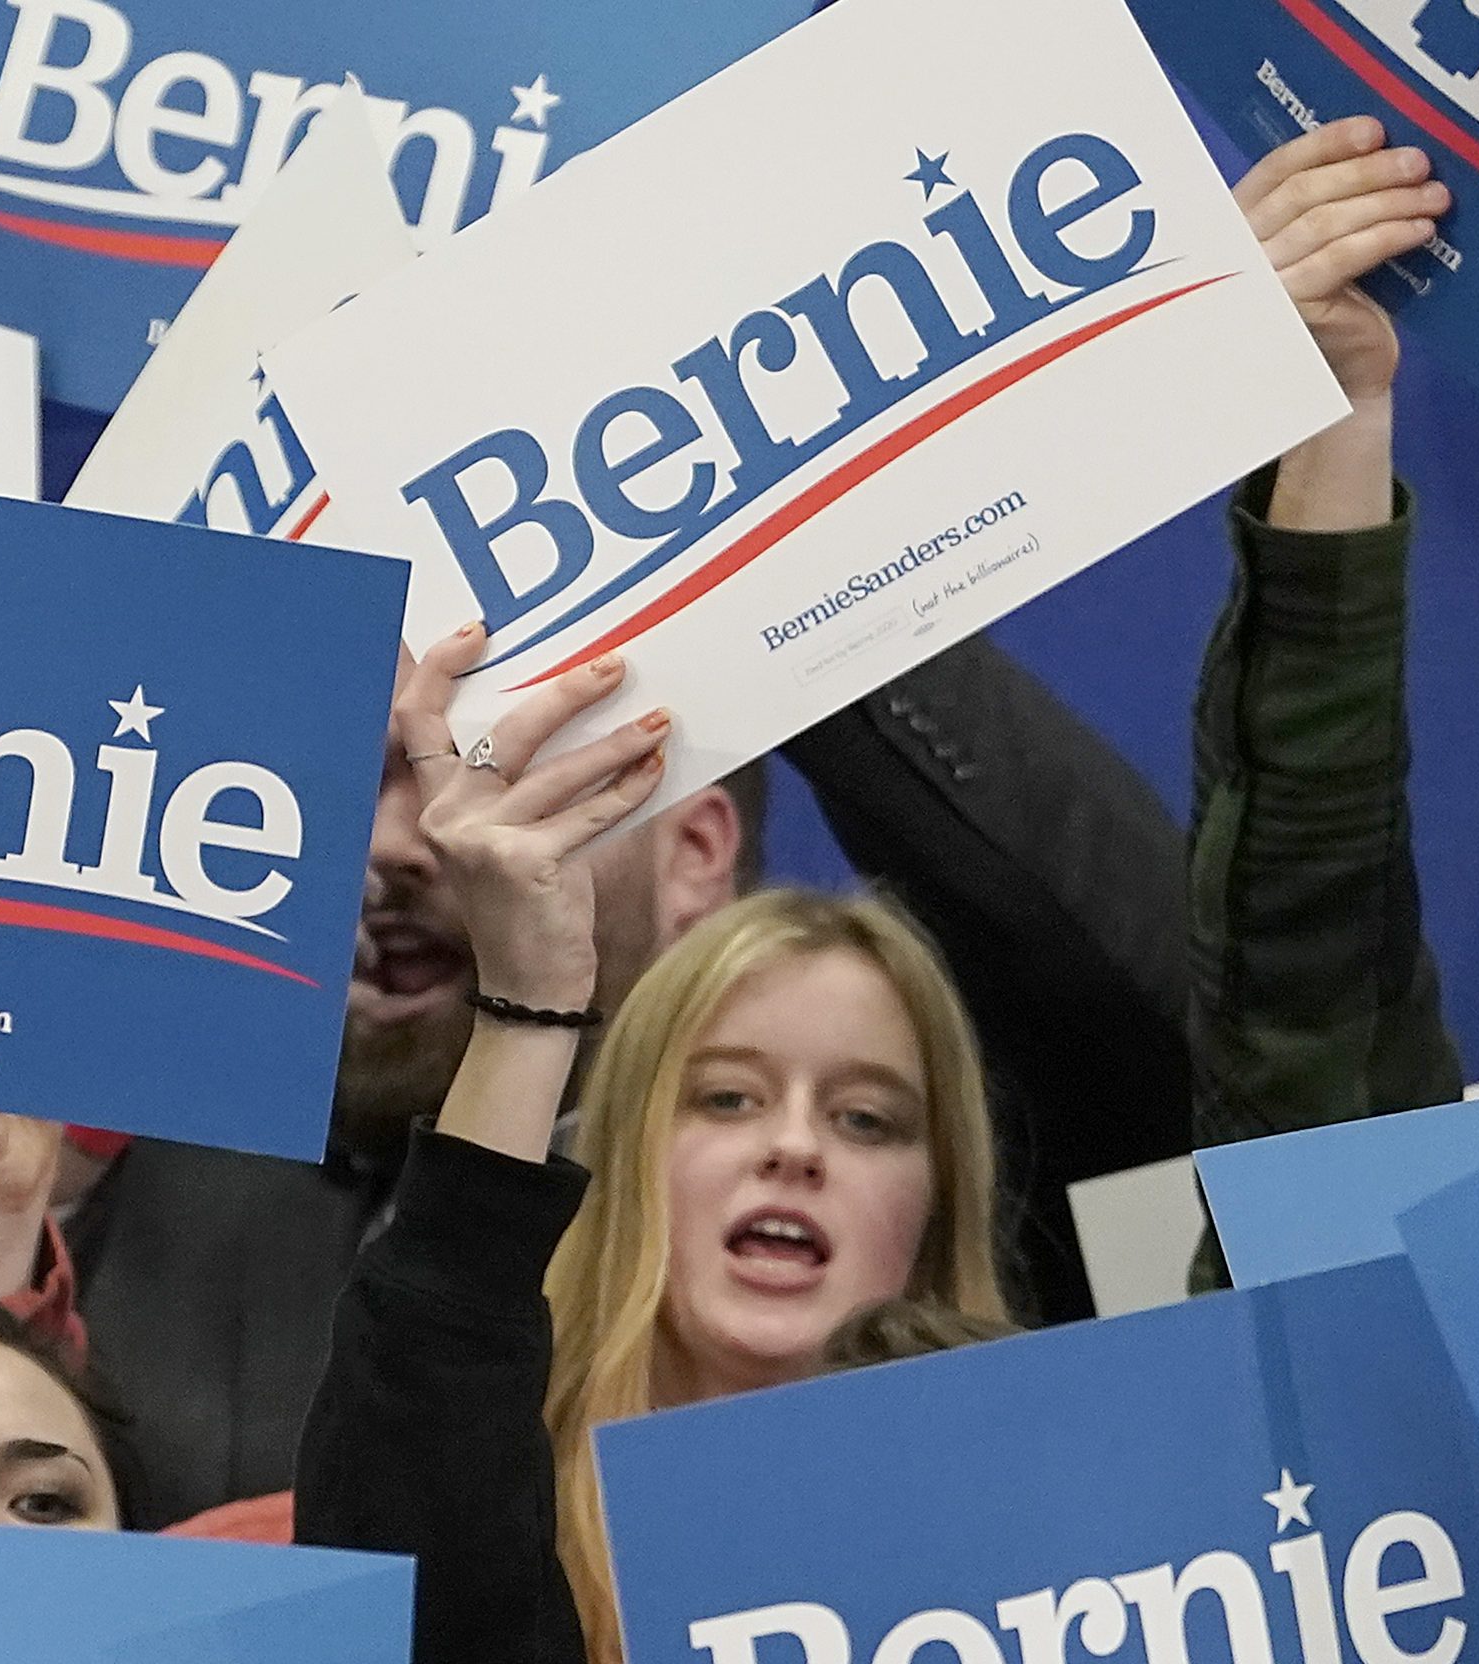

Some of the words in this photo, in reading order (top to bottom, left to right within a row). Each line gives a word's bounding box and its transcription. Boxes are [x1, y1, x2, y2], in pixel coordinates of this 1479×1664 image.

[401, 131, 1156, 640] Bernie
[760, 489, 1028, 653] BernieSanders.com
[912, 597, 939, 617] (not
[943, 580, 966, 600] the
[968, 533, 1040, 585] billionaires)
